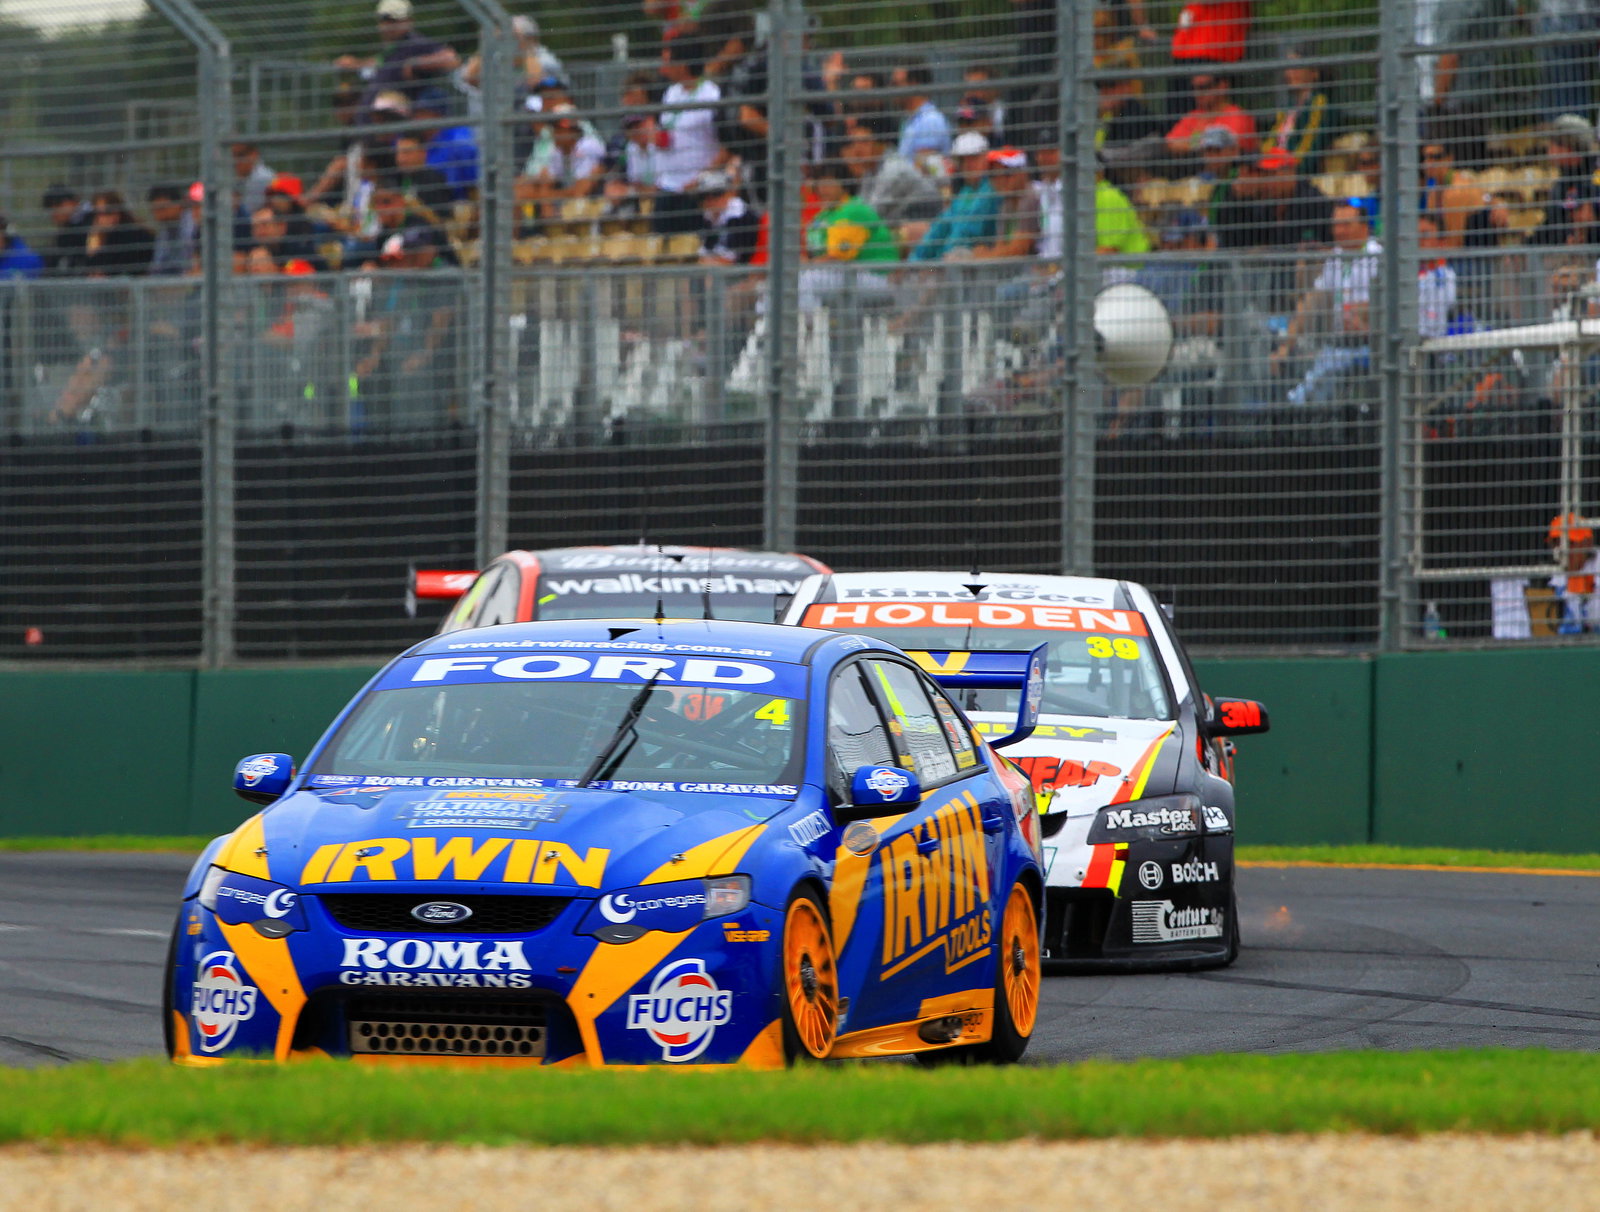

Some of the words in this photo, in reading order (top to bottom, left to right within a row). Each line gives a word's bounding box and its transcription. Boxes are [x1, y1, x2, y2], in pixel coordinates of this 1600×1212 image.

[820, 604, 1132, 632] HOLDEN
[448, 640, 773, 657] www.irwinracing.com.au
[1086, 637, 1141, 660] 39
[411, 655, 776, 685] FORD
[754, 698, 790, 725] 4
[1220, 701, 1262, 728] 3M
[362, 776, 425, 786] ROMA
[427, 777, 544, 788] CARAVANS
[612, 780, 675, 792] ROMA
[679, 782, 798, 796] CARAVANS
[413, 801, 554, 813] ULTIMATE
[1106, 808, 1192, 830] Master
[299, 837, 611, 889] IRWIN
[1171, 861, 1220, 883] BOSCH
[880, 790, 990, 966] IRWIN
[424, 904, 459, 919] Ford
[636, 894, 707, 911] coregas
[949, 909, 992, 963] TOOLS
[339, 938, 533, 970] ROMA
[339, 970, 533, 989] CARAVANS
[193, 986, 253, 1016] FUCHS
[633, 994, 729, 1024] FUCHS
